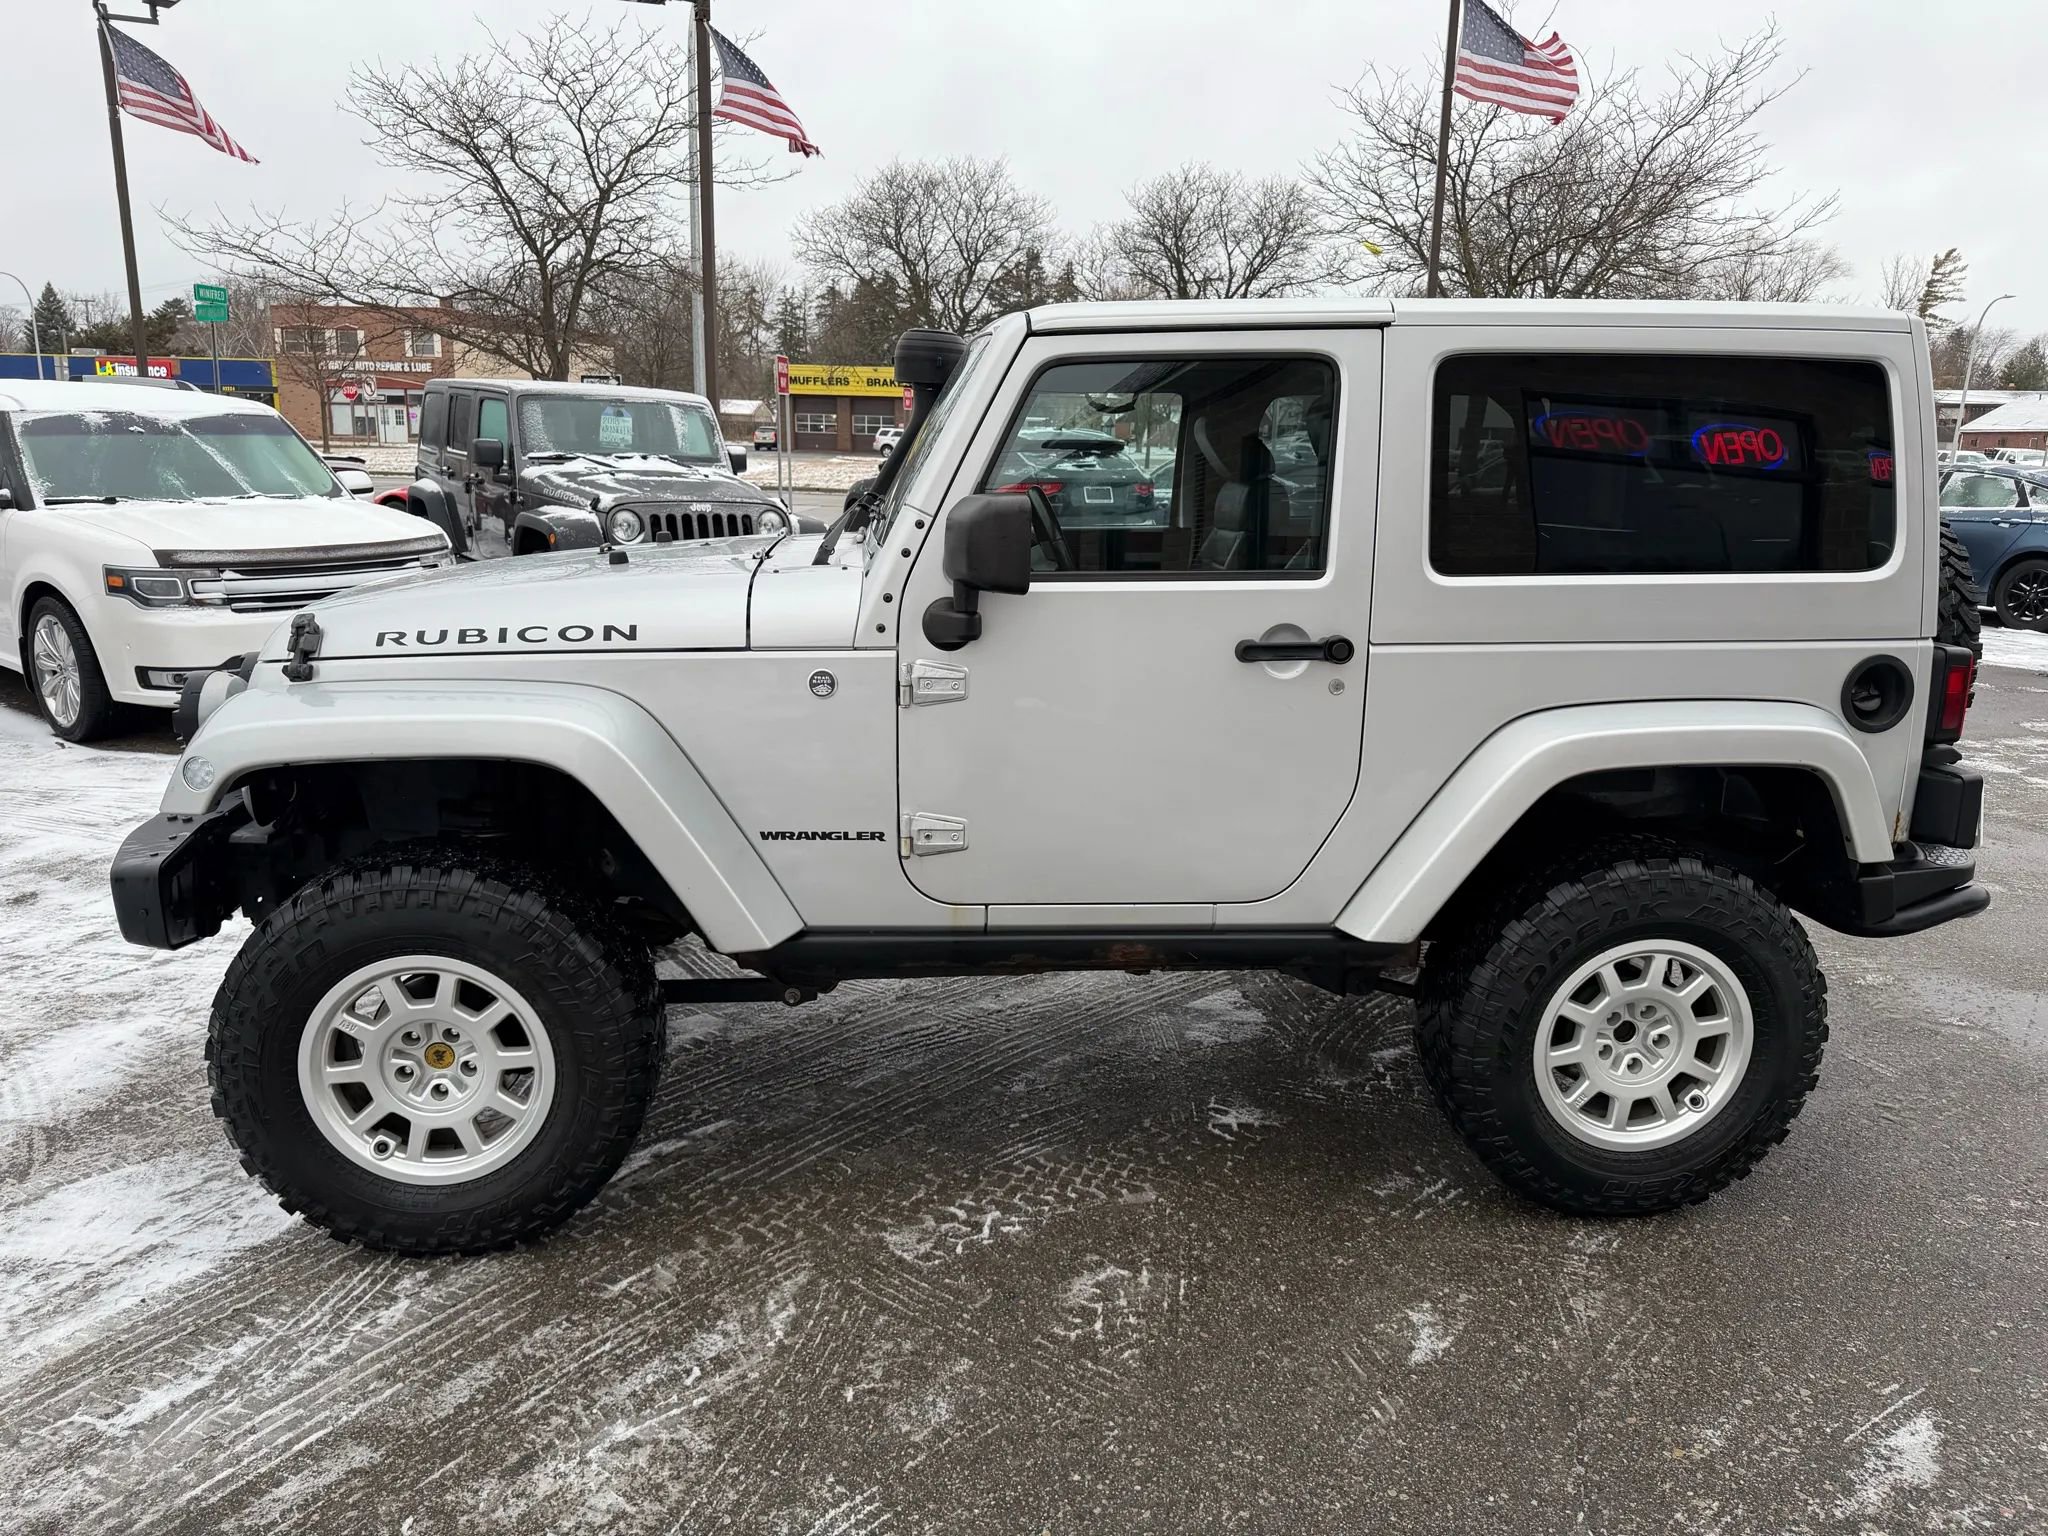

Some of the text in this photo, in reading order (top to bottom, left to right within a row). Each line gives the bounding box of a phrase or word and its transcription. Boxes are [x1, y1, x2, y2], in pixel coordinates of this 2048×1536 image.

[199, 288, 225, 301] WINIFRED
[115, 362, 168, 377] insunce
[355, 361, 375, 371] AUTO
[376, 362, 402, 372] REPAIR
[403, 363, 409, 372] &
[411, 363, 433, 372] LUBE
[789, 376, 850, 387] MUFFLERS
[343, 386, 358, 395] STOP
[690, 504, 712, 512] Jeep
[375, 623, 639, 647] RUBICON
[759, 830, 887, 842] WRANGLER
